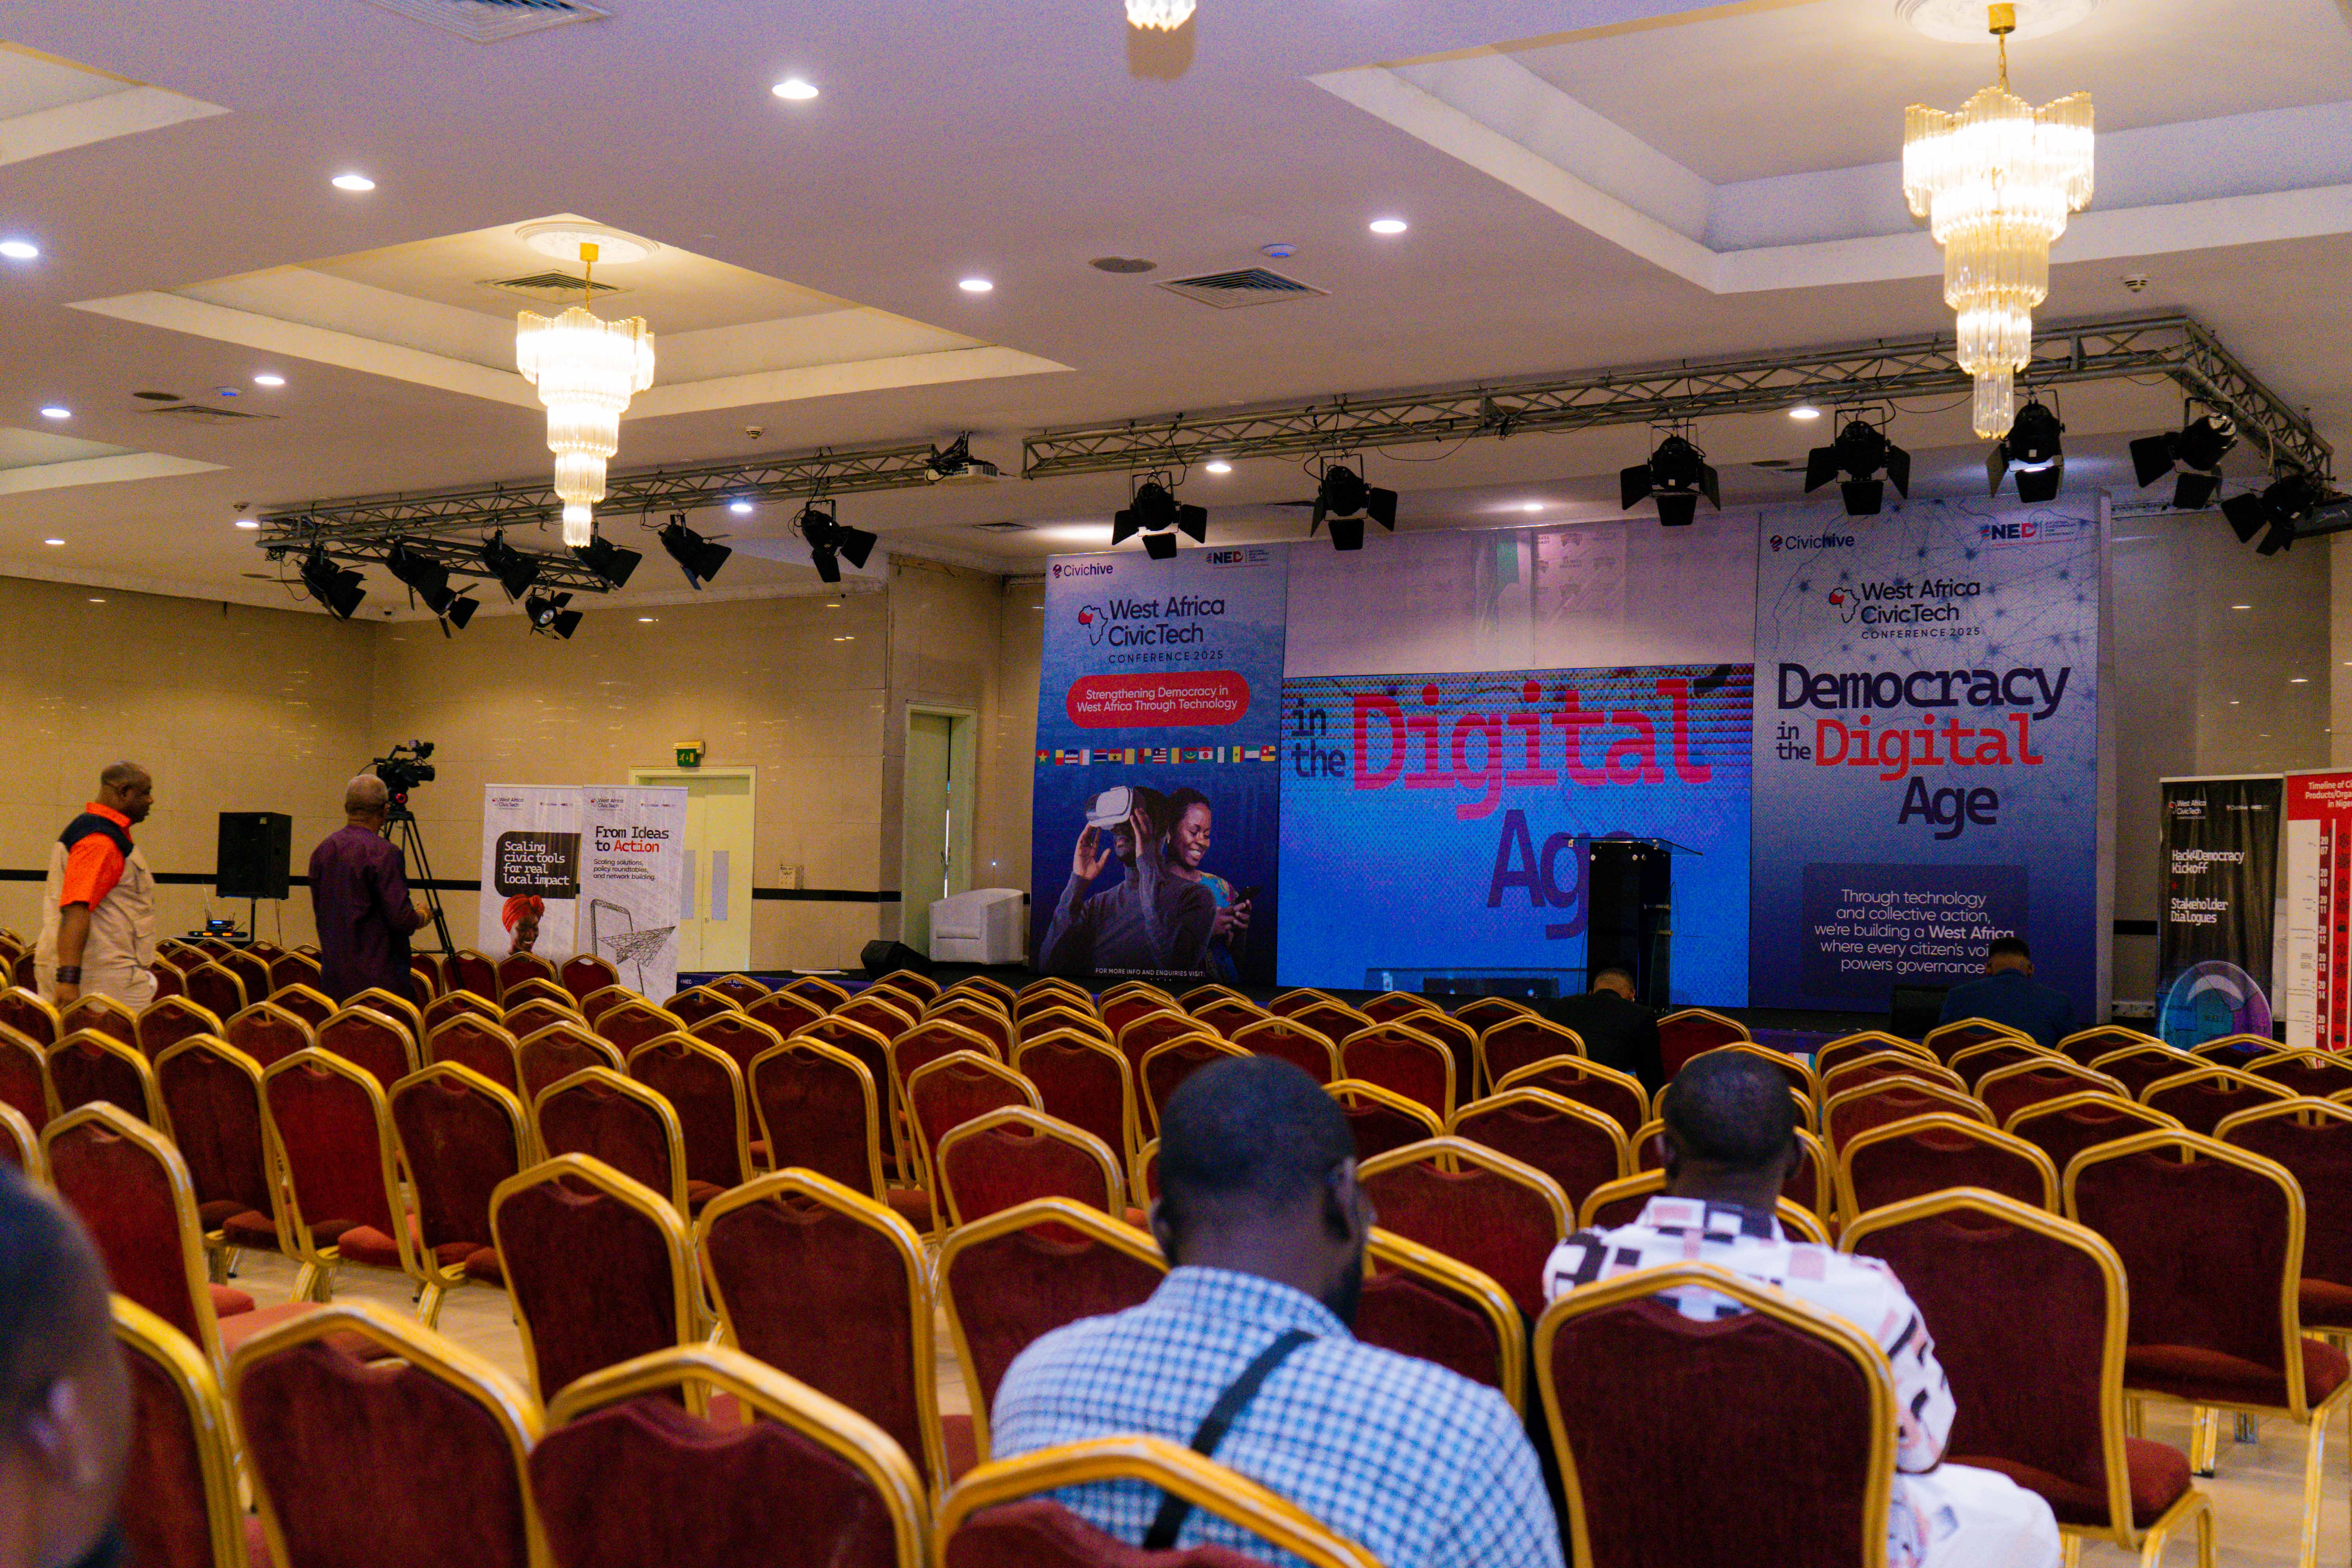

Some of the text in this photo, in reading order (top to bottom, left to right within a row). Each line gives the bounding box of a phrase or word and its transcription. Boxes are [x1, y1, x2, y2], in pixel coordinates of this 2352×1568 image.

[1992, 523, 2037, 539] NED
[1786, 534, 1855, 549] Civichive
[1213, 551, 1243, 564] NED
[1063, 563, 1113, 577] Civichive
[1862, 578, 1980, 601] West Africa
[1109, 595, 1225, 620] West Africa
[1861, 603, 1959, 624] CivicTech
[1108, 622, 1203, 646] CivicTech
[1862, 627, 1980, 639] CONFERENCE 2025
[1109, 650, 1223, 663] CONFERENCE 2025
[1086, 685, 1228, 701] Strengthening Democracy in
[1778, 662, 2071, 721] Democracy
[1077, 698, 1238, 712] West Africa Through Technology
[1291, 699, 1327, 737] in
[1777, 722, 1799, 740] in
[1291, 678, 1712, 820] the Digital
[1776, 712, 2044, 781] the Digital
[2308, 781, 2336, 789] Timeline
[2337, 780, 2345, 788] of
[1898, 776, 1999, 840] Age
[2327, 800, 2334, 808] in
[596, 826, 669, 839] From Ideas
[595, 839, 659, 853] to Action
[2320, 836, 2329, 845] 20
[505, 841, 546, 855] Scaling
[2320, 846, 2328, 855] 07
[504, 851, 566, 863] civic tools
[503, 862, 549, 874] for real
[1487, 809, 1637, 940] Ag
[2172, 861, 2209, 874] Kickoff
[2320, 868, 2328, 877] 20
[503, 873, 570, 888] local impact
[1841, 889, 1986, 908] Through technology
[2171, 897, 2229, 911] Stakeholder
[2320, 895, 2328, 904] 20
[1836, 907, 1991, 924] and collective action,
[2171, 910, 2217, 926] Dialogues
[1814, 923, 2014, 940] we're building a West Africa
[2319, 925, 2327, 935] 20
[2319, 935, 2327, 944] 12
[1820, 940, 1989, 957] where every citizen's voi
[2319, 953, 2327, 962] 20
[1841, 959, 1985, 975] powers governance
[2318, 980, 2326, 989] 20
[2318, 1014, 2326, 1024] 20
[2318, 1024, 2325, 1034] 15
